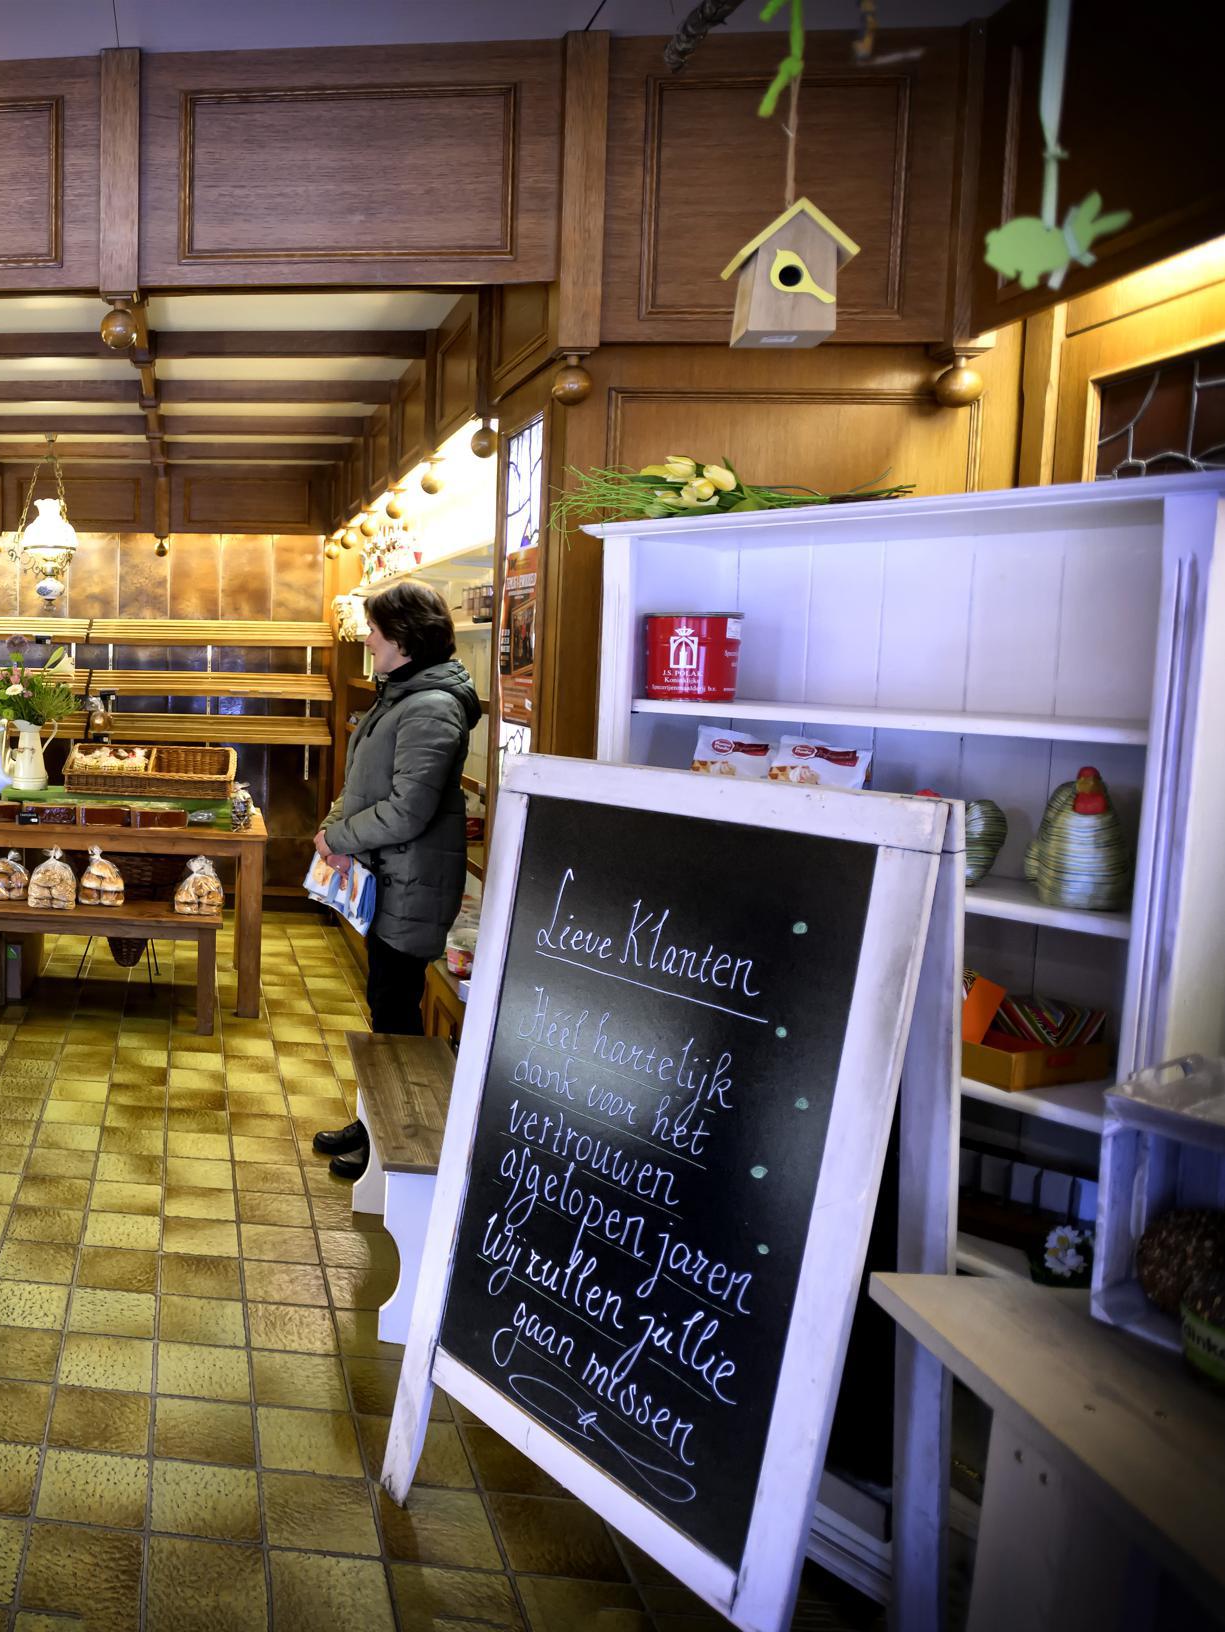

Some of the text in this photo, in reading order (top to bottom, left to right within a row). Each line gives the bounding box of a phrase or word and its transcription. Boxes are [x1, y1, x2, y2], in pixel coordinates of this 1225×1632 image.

[536, 868, 761, 997] Lieve Klanten
[513, 1045, 711, 1156] dank voor het
[593, 1011, 734, 1130] hartelijk
[508, 1099, 680, 1206] vertrouwen
[500, 1147, 753, 1316] afgelopen jaren
[481, 1212, 737, 1405] Wij zullen jullie
[491, 1301, 695, 1466] gaan missen
